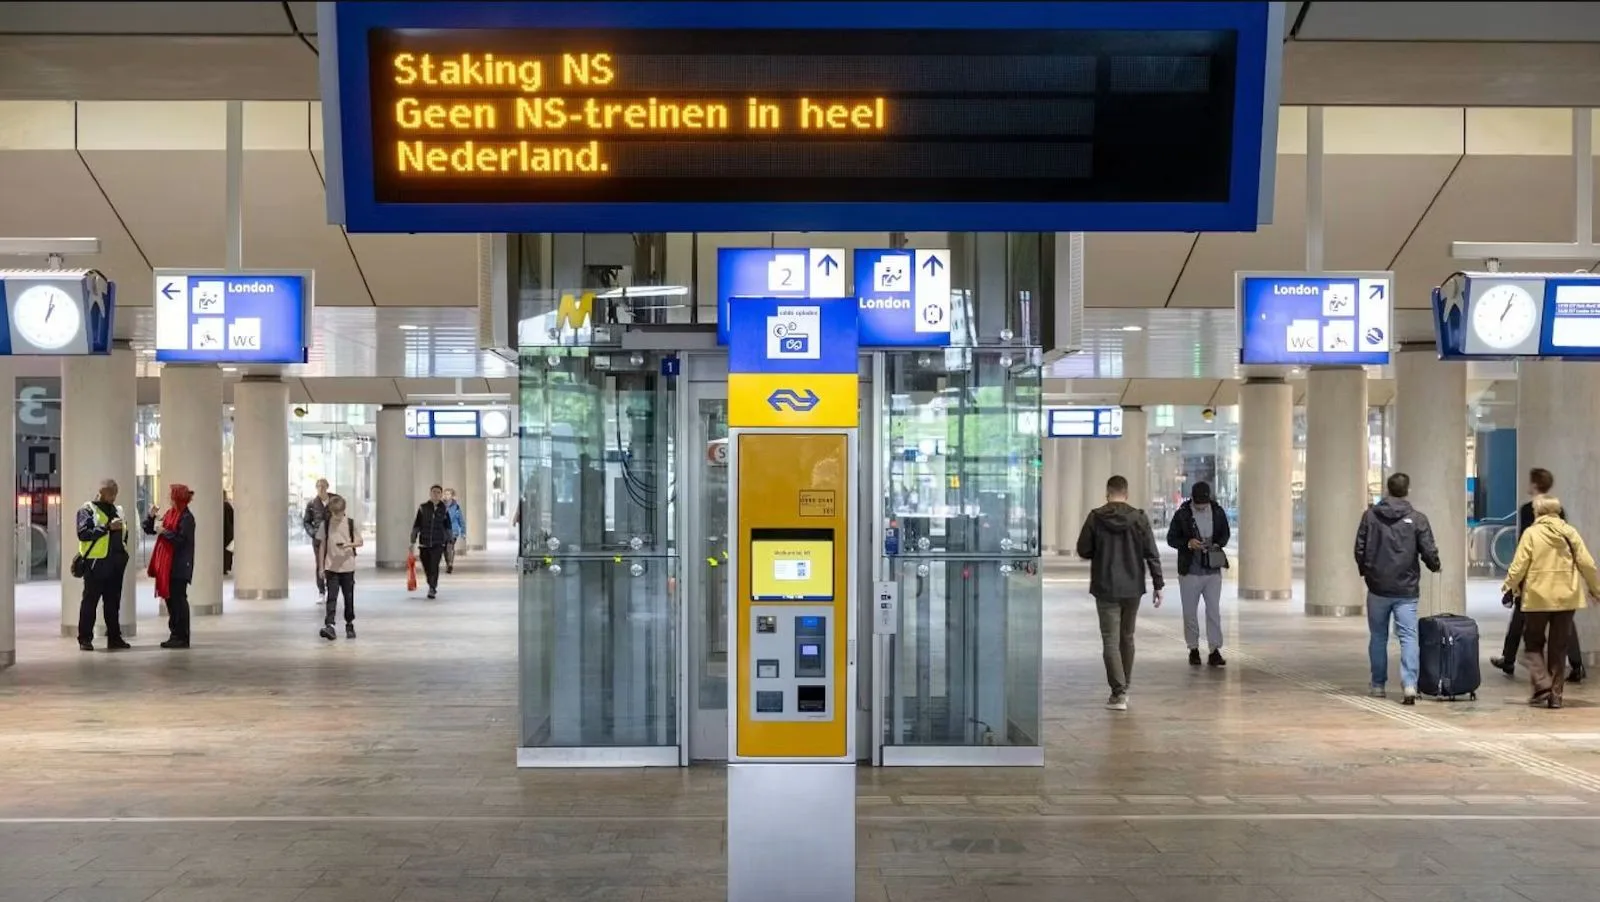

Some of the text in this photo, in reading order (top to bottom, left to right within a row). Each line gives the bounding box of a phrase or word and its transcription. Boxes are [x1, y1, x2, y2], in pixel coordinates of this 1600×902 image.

[394, 53, 614, 92] Staking NS
[396, 97, 884, 129] Geen NS-treinen in heel
[397, 140, 609, 171] Nederland.
[781, 268, 792, 286] 2
[228, 282, 275, 293] London
[1274, 284, 1319, 295] London
[859, 298, 910, 309] London
[233, 336, 256, 346] WC
[1291, 337, 1315, 348] WC
[667, 361, 673, 373] 1
